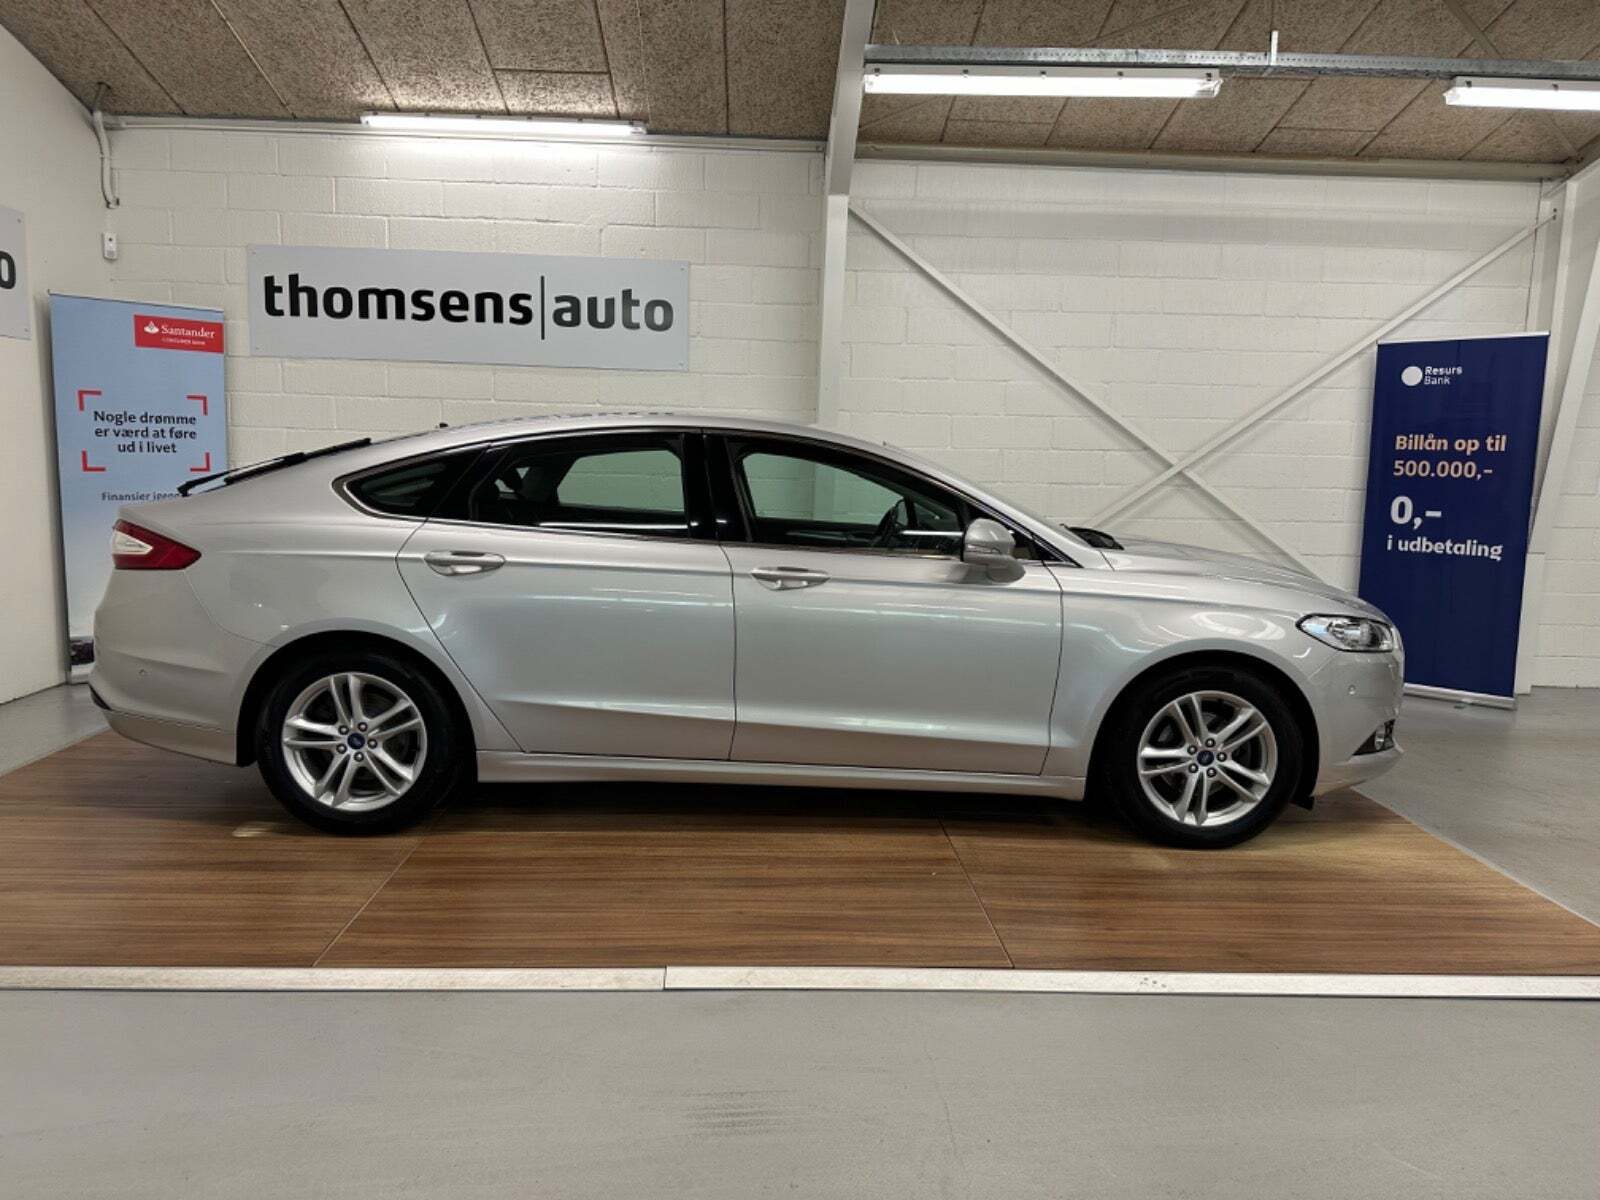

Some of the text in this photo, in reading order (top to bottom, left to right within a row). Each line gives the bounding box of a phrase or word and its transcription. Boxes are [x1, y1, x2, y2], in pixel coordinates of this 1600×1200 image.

[263, 273, 674, 332] thomsens auto
[161, 324, 216, 338] Santander
[1425, 366, 1463, 376] Resurs
[1424, 375, 1451, 385] Bank
[93, 410, 197, 426] Nogle drømme
[94, 426, 197, 439] er værd at føre
[117, 441, 177, 454] ud i livet
[1395, 433, 1507, 456] Billån op til
[1386, 534, 1504, 562] i udbetaling
